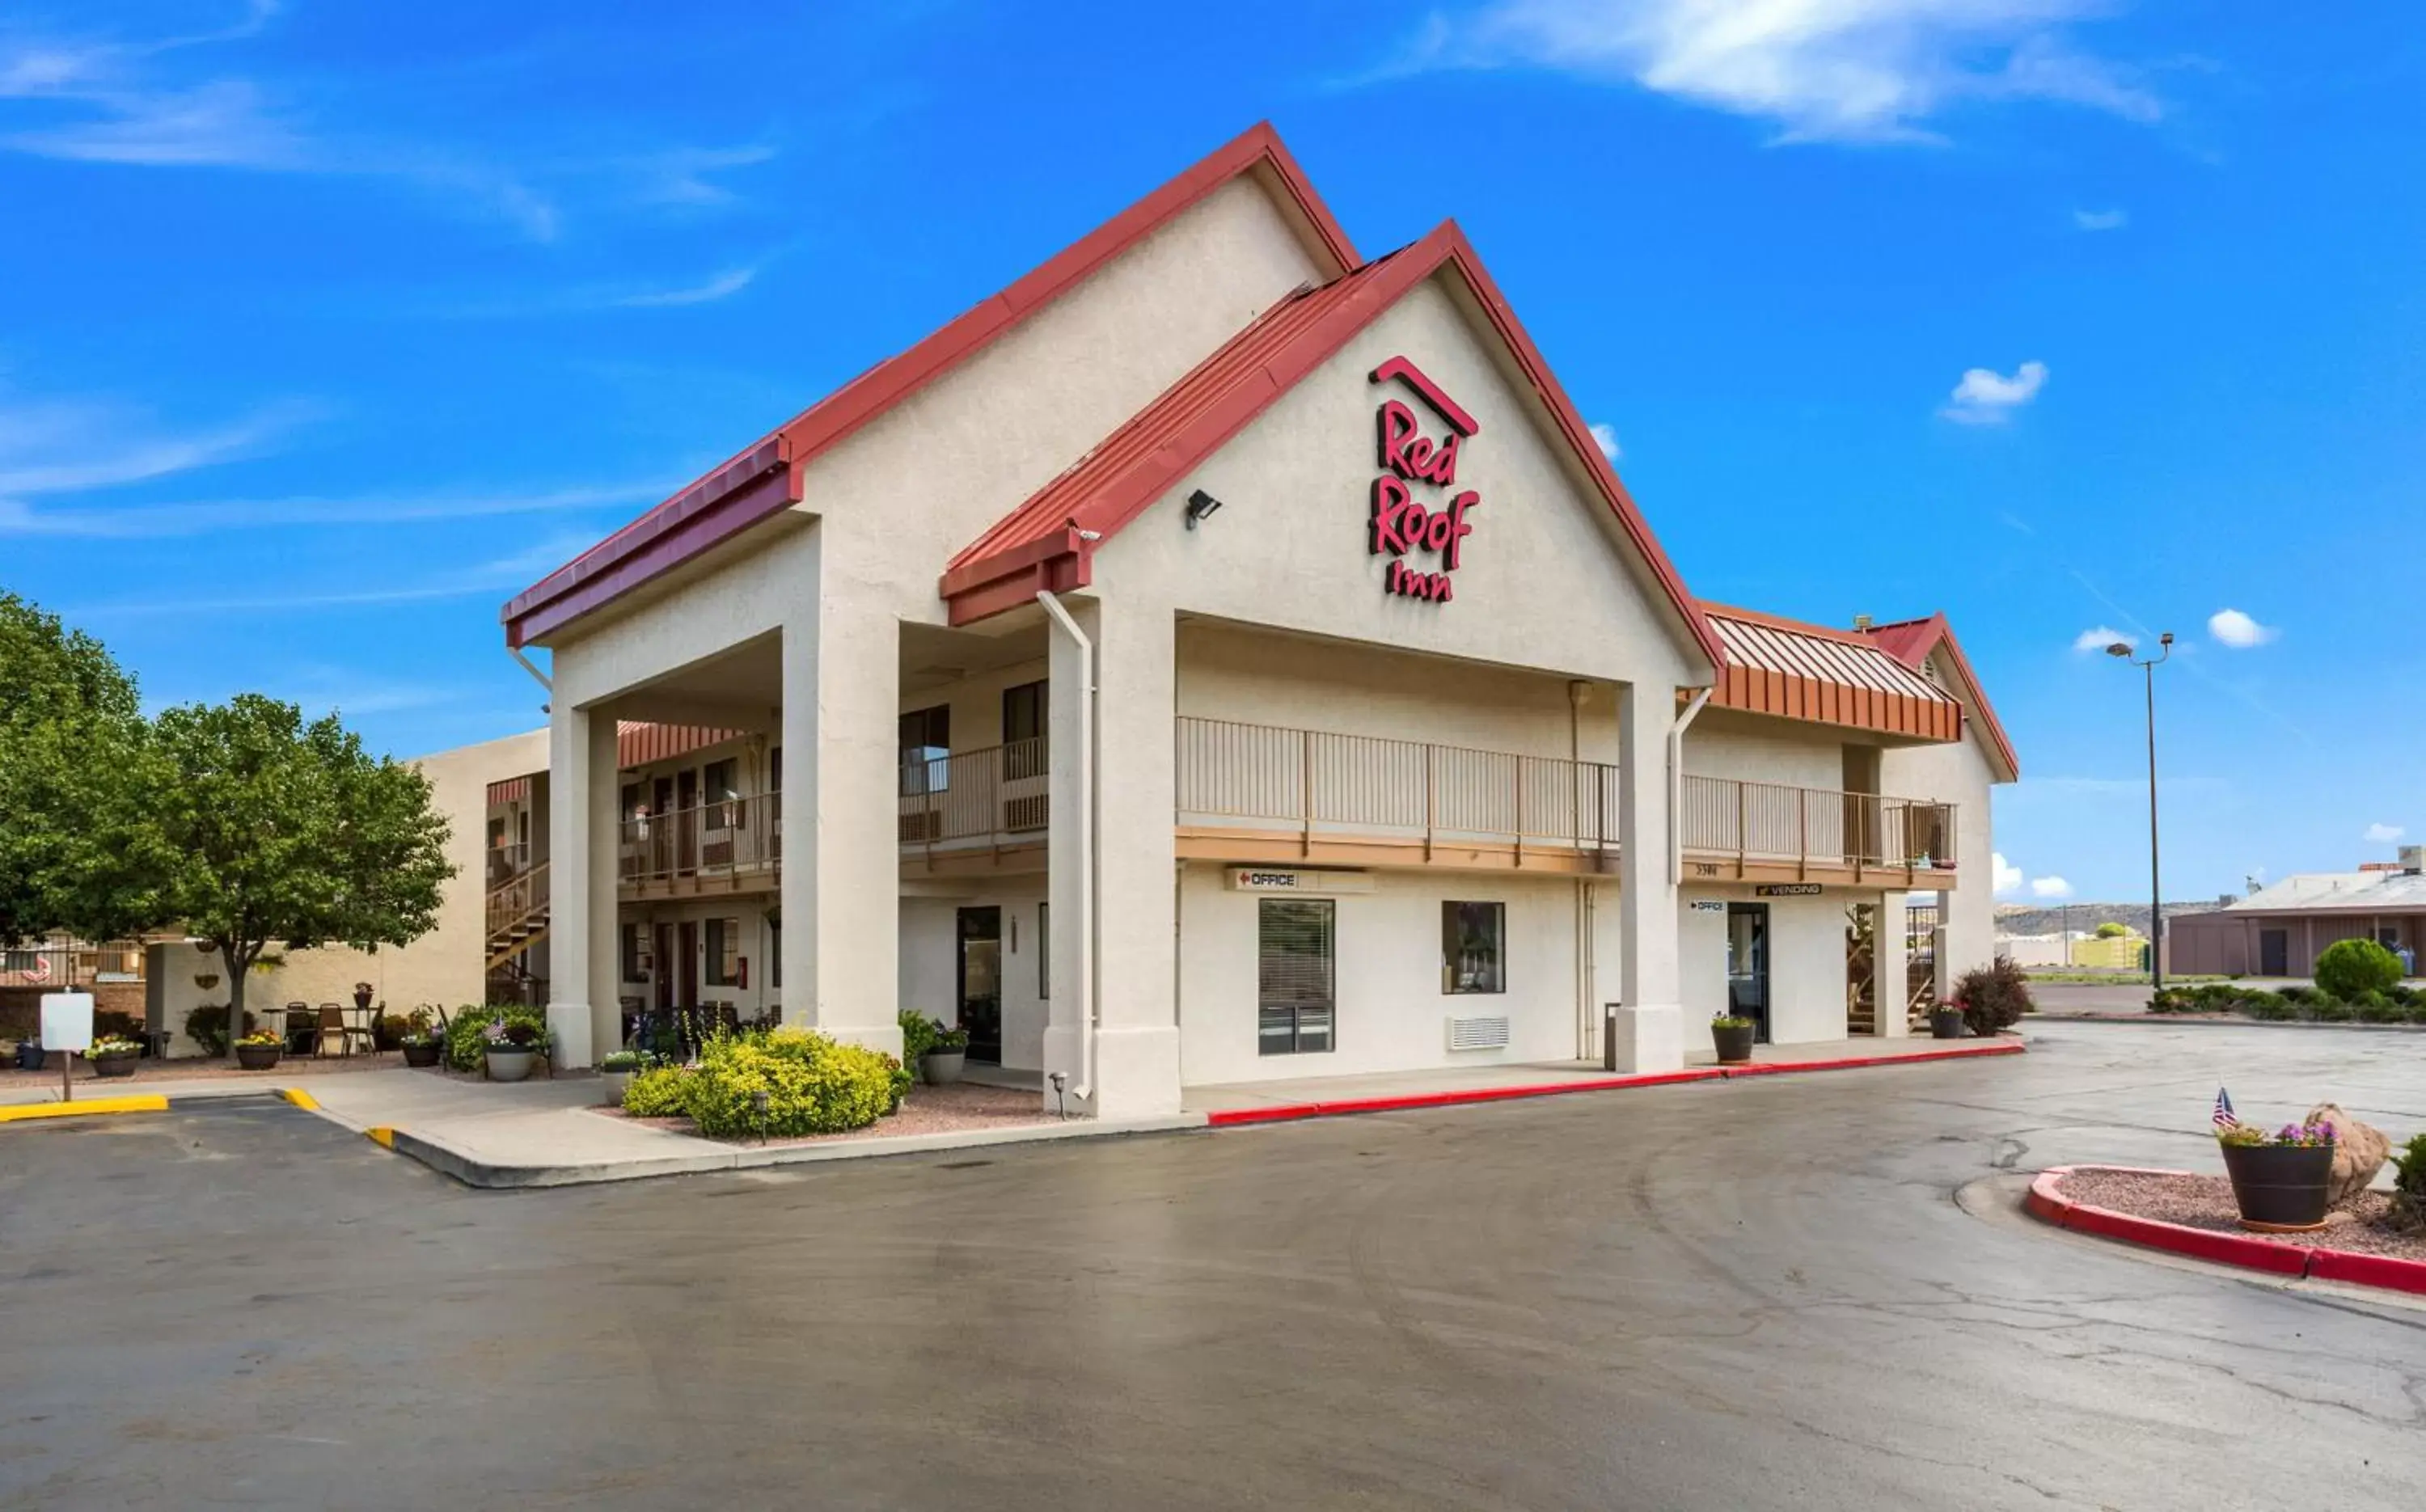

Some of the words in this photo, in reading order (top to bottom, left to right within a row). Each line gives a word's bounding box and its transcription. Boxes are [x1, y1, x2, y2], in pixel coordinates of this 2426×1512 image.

[1378, 399, 1460, 485] Red
[1370, 475, 1480, 571] Roof
[1386, 560, 1452, 602] Inn
[1252, 873, 1294, 885] OFFICE
[1772, 885, 1820, 895] VENDING
[1698, 902, 1722, 910] OFFICE
